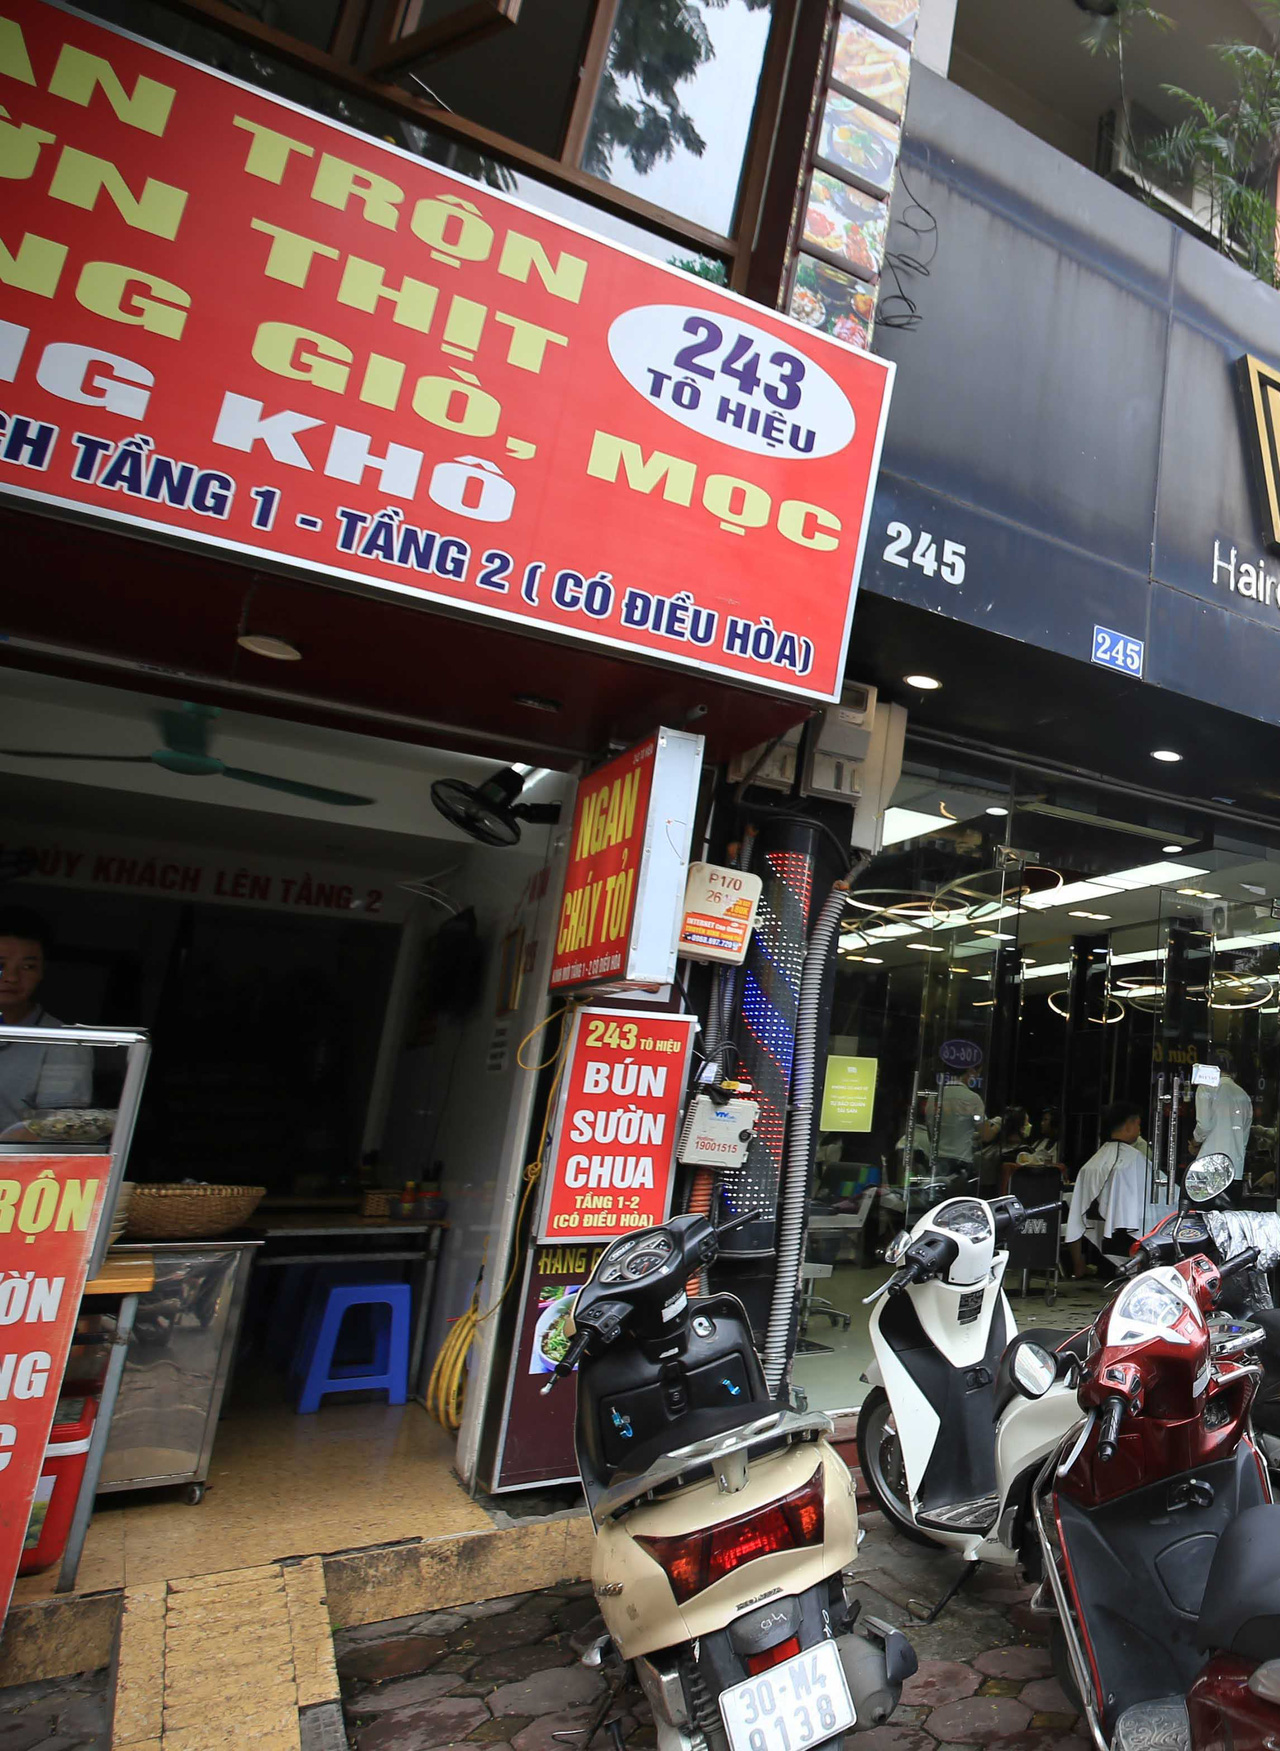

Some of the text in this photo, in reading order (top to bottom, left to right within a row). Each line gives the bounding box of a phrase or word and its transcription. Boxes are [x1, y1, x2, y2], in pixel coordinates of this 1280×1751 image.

[232, 114, 588, 304] TRỘN
[250, 217, 569, 374] THỊT
[673, 315, 806, 411] 243
[0, 319, 516, 523] G KHÔ
[251, 322, 537, 460] GIÒ,
[586, 429, 842, 552] MỌC
[646, 366, 816, 454] TÔ HIỆU
[71, 433, 236, 520] TẦNG
[250, 485, 282, 532] 1
[336, 506, 471, 583] TẦNG
[476, 549, 514, 594] 2
[620, 588, 717, 647] ĐIỀU
[724, 614, 815, 676] HÒA)
[882, 521, 966, 585] 245
[1096, 633, 1140, 670] 245
[575, 767, 641, 862] NGAN
[93, 856, 201, 895] KHÁCH
[213, 867, 272, 901] LÊN
[281, 872, 353, 910] TẦNG
[364, 888, 384, 914] 2
[557, 871, 603, 955] CHÁY
[600, 848, 634, 943] TỎI
[708, 873, 743, 891] P170
[585, 1020, 682, 1055] 243 TÔ HIỆU
[582, 1058, 668, 1098] BÚN
[570, 1104, 666, 1145] SƯỜN
[695, 1141, 738, 1153] 19001515
[564, 1154, 654, 1189] CHUA
[574, 1191, 641, 1209] TẦNG 1-2
[553, 1211, 654, 1229] (CÓ ĐIỀU HÒA)
[0, 1271, 65, 1326] ỜN
[740, 1655, 827, 1724] 30-M4
